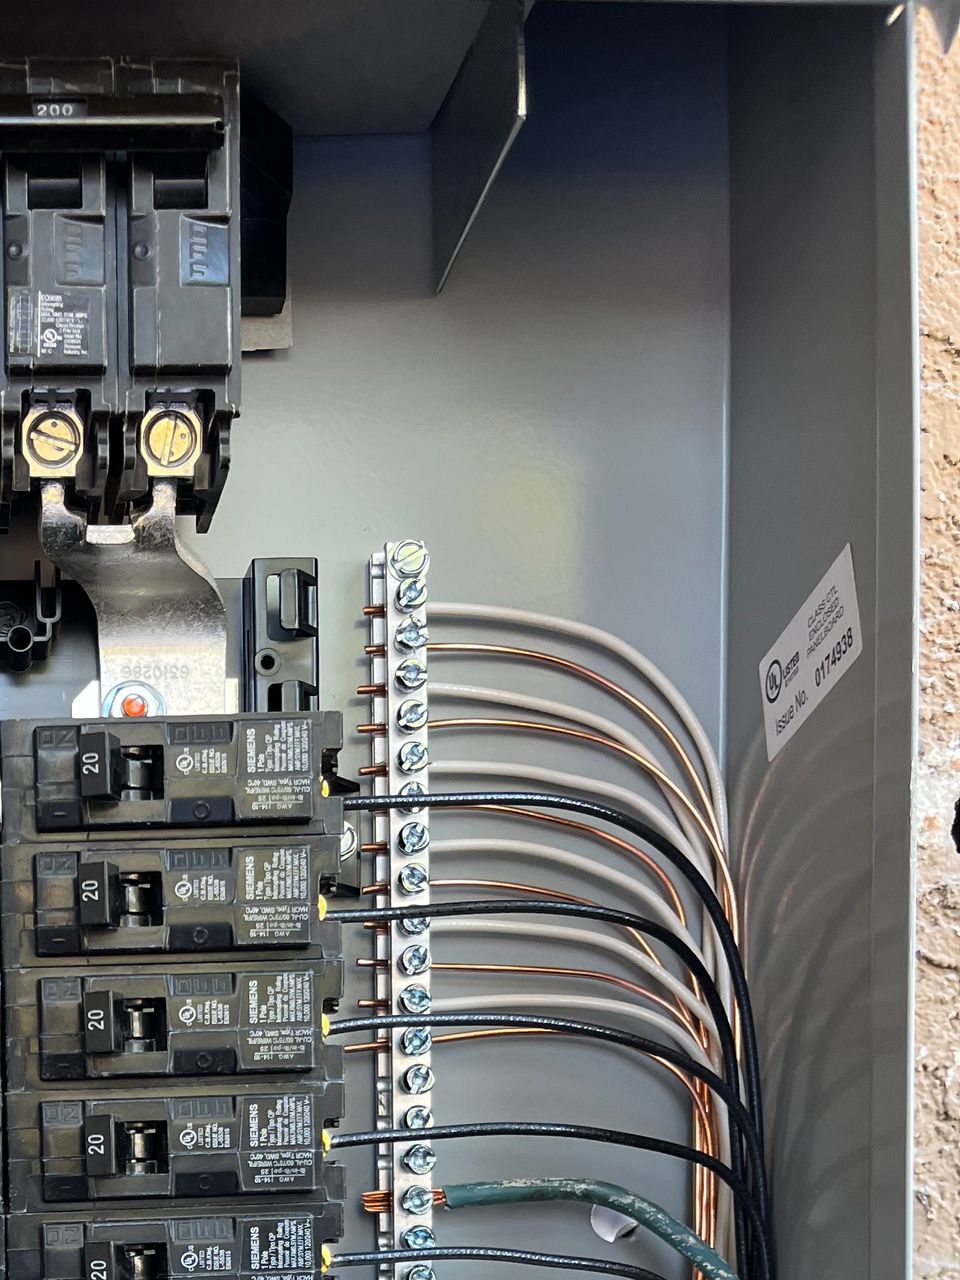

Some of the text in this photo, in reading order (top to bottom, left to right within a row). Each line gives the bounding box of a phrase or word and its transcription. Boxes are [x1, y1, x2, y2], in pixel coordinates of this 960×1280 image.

[37, 104, 73, 116] 200
[807, 605, 844, 659] PANELBOARD
[808, 597, 839, 642] ENCLOSED
[783, 651, 799, 679] LISTED
[815, 627, 853, 687] 0174938
[776, 705, 794, 736] Issue
[795, 690, 808, 712] No.
[82, 753, 99, 774] 20
[247, 729, 256, 773] SIEMENS
[82, 881, 98, 901] 20
[246, 856, 254, 900] SIEMENS
[88, 1010, 104, 1030] 20
[249, 980, 258, 1023] SIEMENS
[88, 1135, 104, 1154] 20
[249, 1104, 258, 1147] SIEMENS
[251, 1227, 259, 1269] SIEMENS
[91, 1261, 106, 1280] 20
